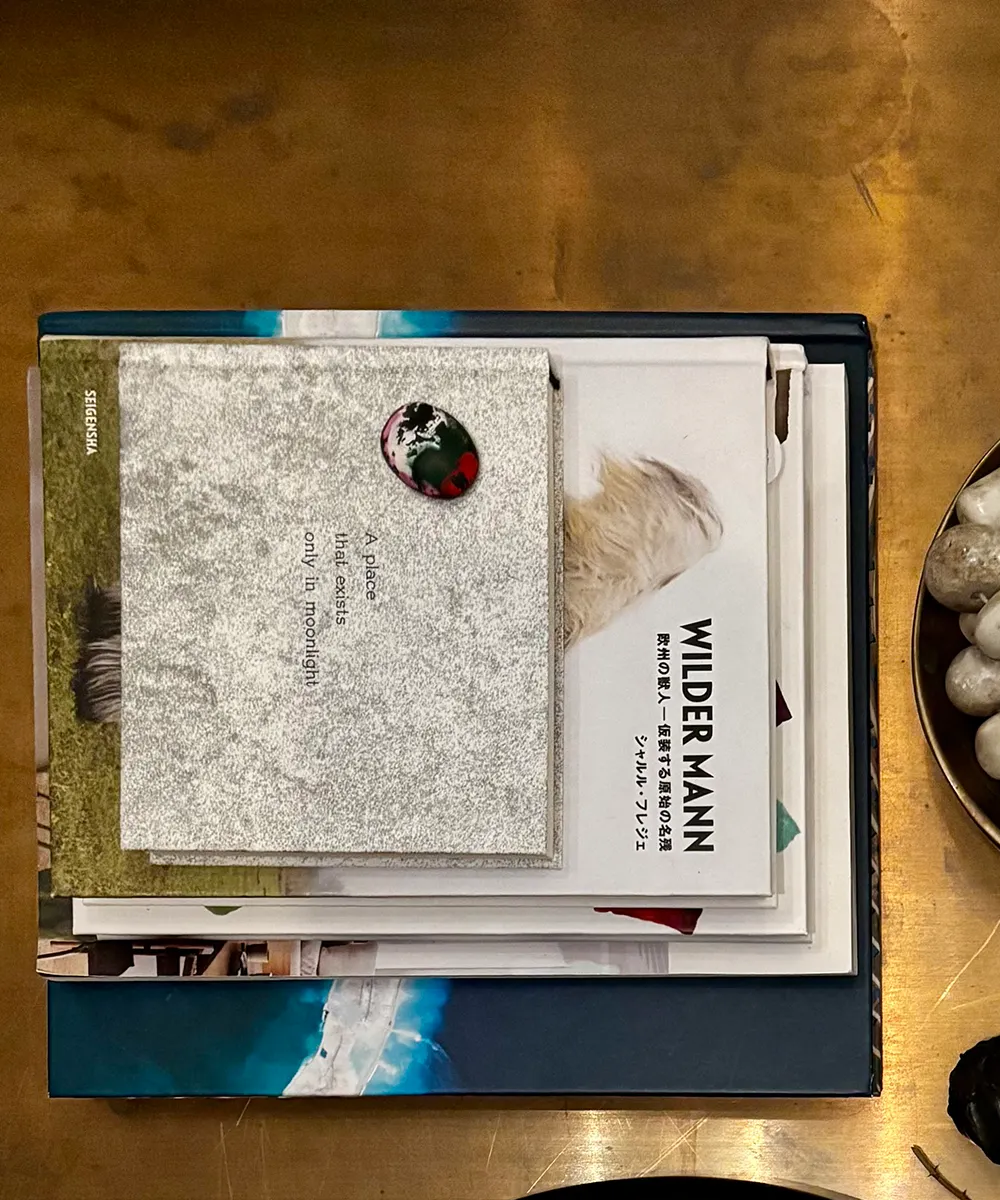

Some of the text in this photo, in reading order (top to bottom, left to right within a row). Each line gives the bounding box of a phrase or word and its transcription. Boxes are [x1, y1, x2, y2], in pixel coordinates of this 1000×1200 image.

[85, 390, 98, 455] SEIGENSHA
[301, 532, 320, 687] only in moonlight
[335, 533, 349, 625] that exists
[362, 532, 379, 600] A place
[679, 618, 714, 852] WILDER MANN
